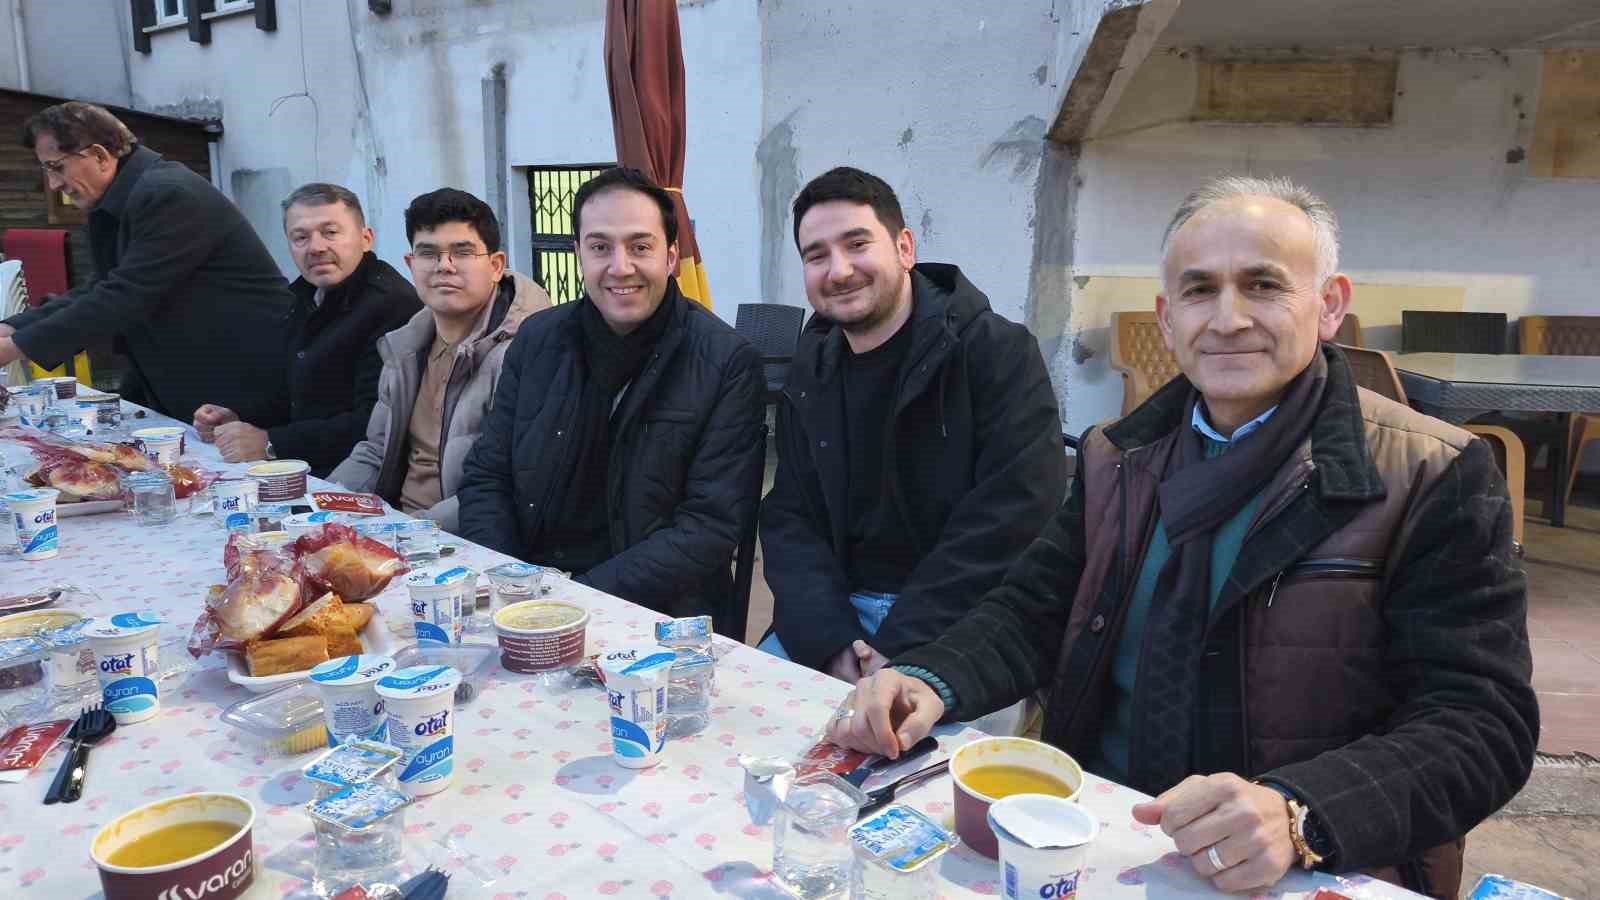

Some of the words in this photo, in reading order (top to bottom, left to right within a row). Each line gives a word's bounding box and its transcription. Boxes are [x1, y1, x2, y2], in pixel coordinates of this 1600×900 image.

[101, 653, 135, 672] otat
[104, 685, 139, 698] ayran
[415, 710, 448, 736] otat
[416, 746, 450, 766] ayran
[184, 849, 252, 900] varan
[1040, 868, 1081, 899] otat
